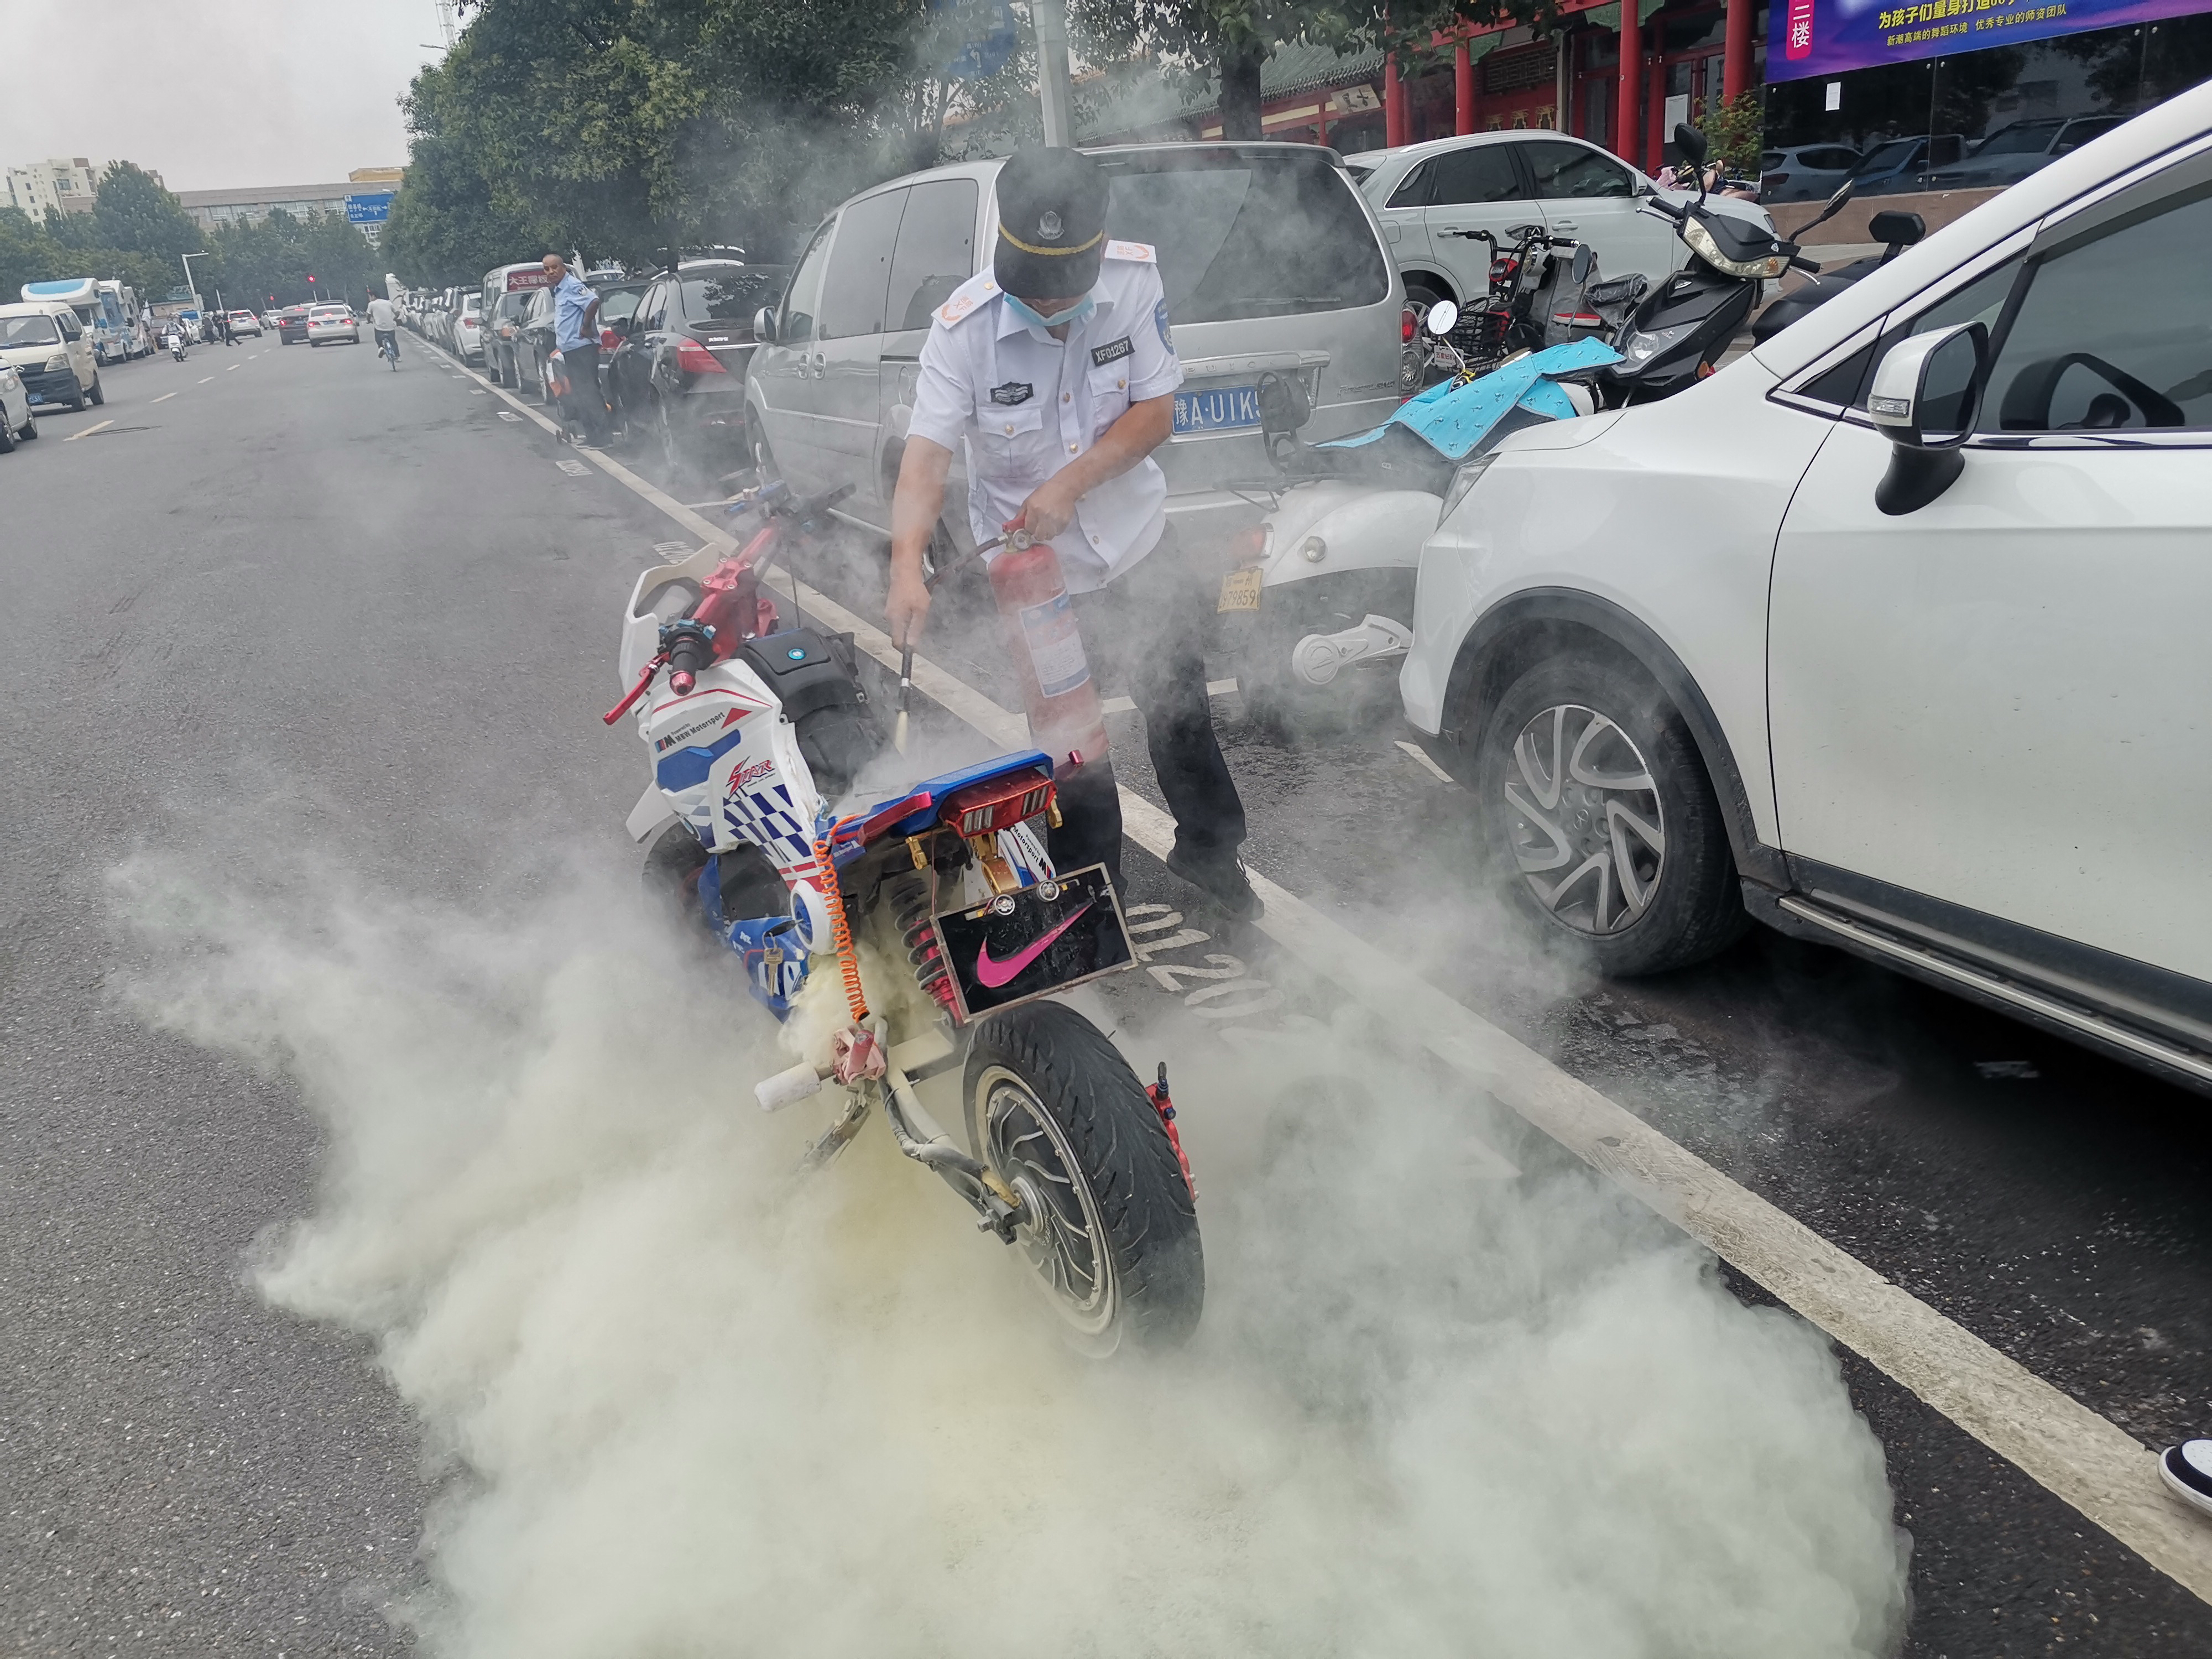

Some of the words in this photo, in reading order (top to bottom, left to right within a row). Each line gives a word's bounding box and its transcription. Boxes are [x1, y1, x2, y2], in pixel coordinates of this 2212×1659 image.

[1792, 4, 1811, 48] 二楼
[1886, 22, 1968, 46] 新潮高端的舞蹈环境
[1975, 4, 2067, 31] 优秀专业的师资团队
[1095, 340, 1129, 363] XF01267
[1185, 360, 1274, 374] BUICK
[690, 712, 726, 735] Motorsport
[1013, 827, 1039, 863] Motorsport
